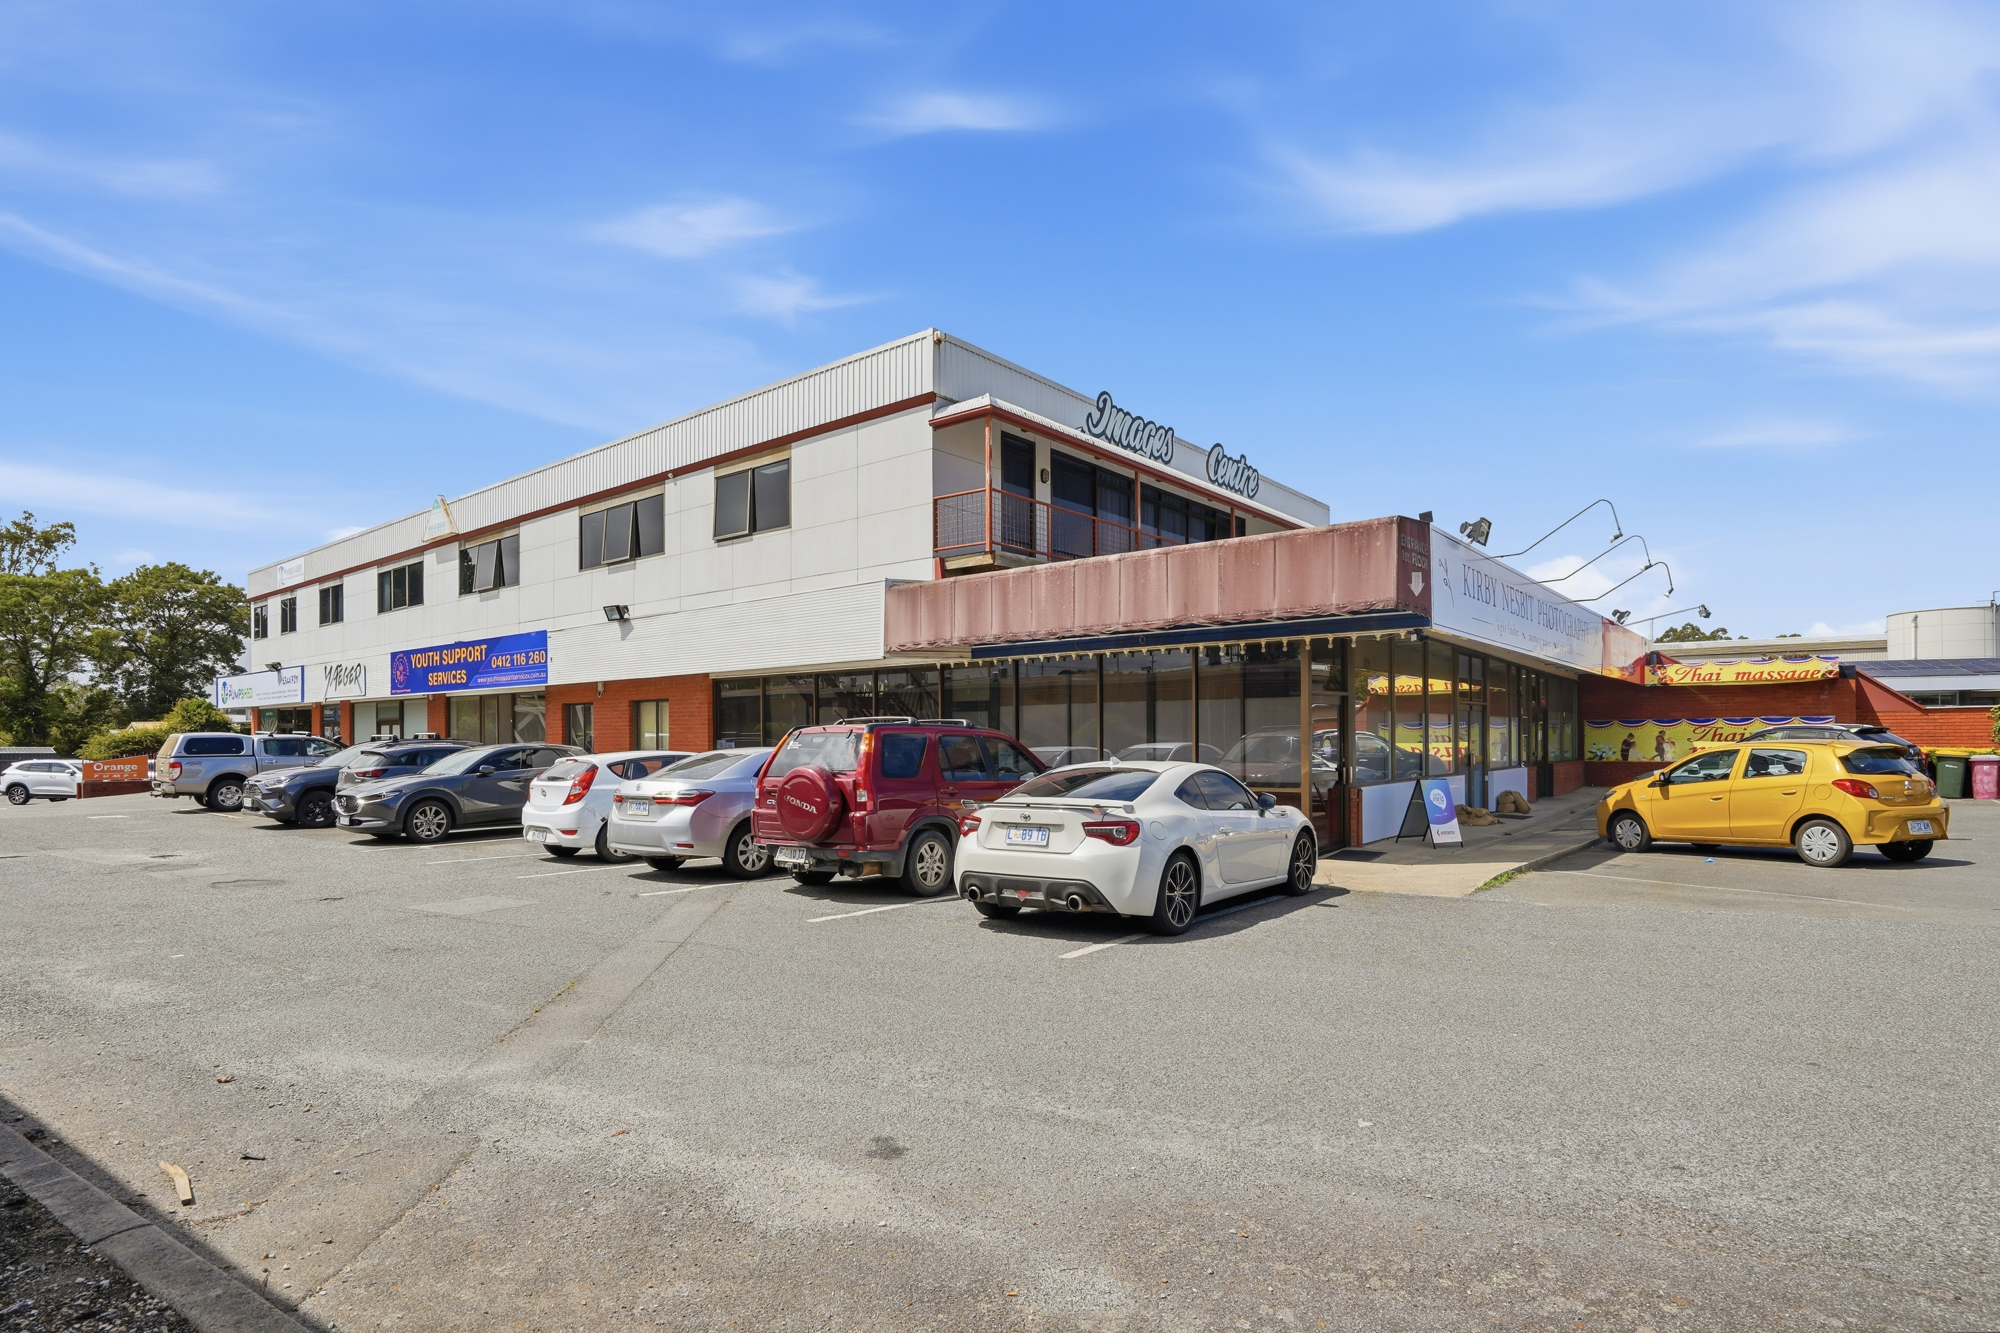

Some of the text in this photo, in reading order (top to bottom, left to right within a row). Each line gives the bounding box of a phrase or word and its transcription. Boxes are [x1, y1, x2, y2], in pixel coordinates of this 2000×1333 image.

[1086, 391, 1260, 499] Images Centre
[1462, 563, 1590, 643] KIRBY NESBIT PHOTOGRAPHY
[410, 652, 440, 669] YOUTH
[442, 645, 487, 665] SUPPORT
[491, 650, 546, 669] 0412 116 260
[428, 669, 467, 686] SERVICES
[1674, 666, 1821, 682] Thai massage
[1686, 726, 1748, 743] Thai
[93, 762, 138, 772] Orange
[784, 795, 818, 815] HONDA
